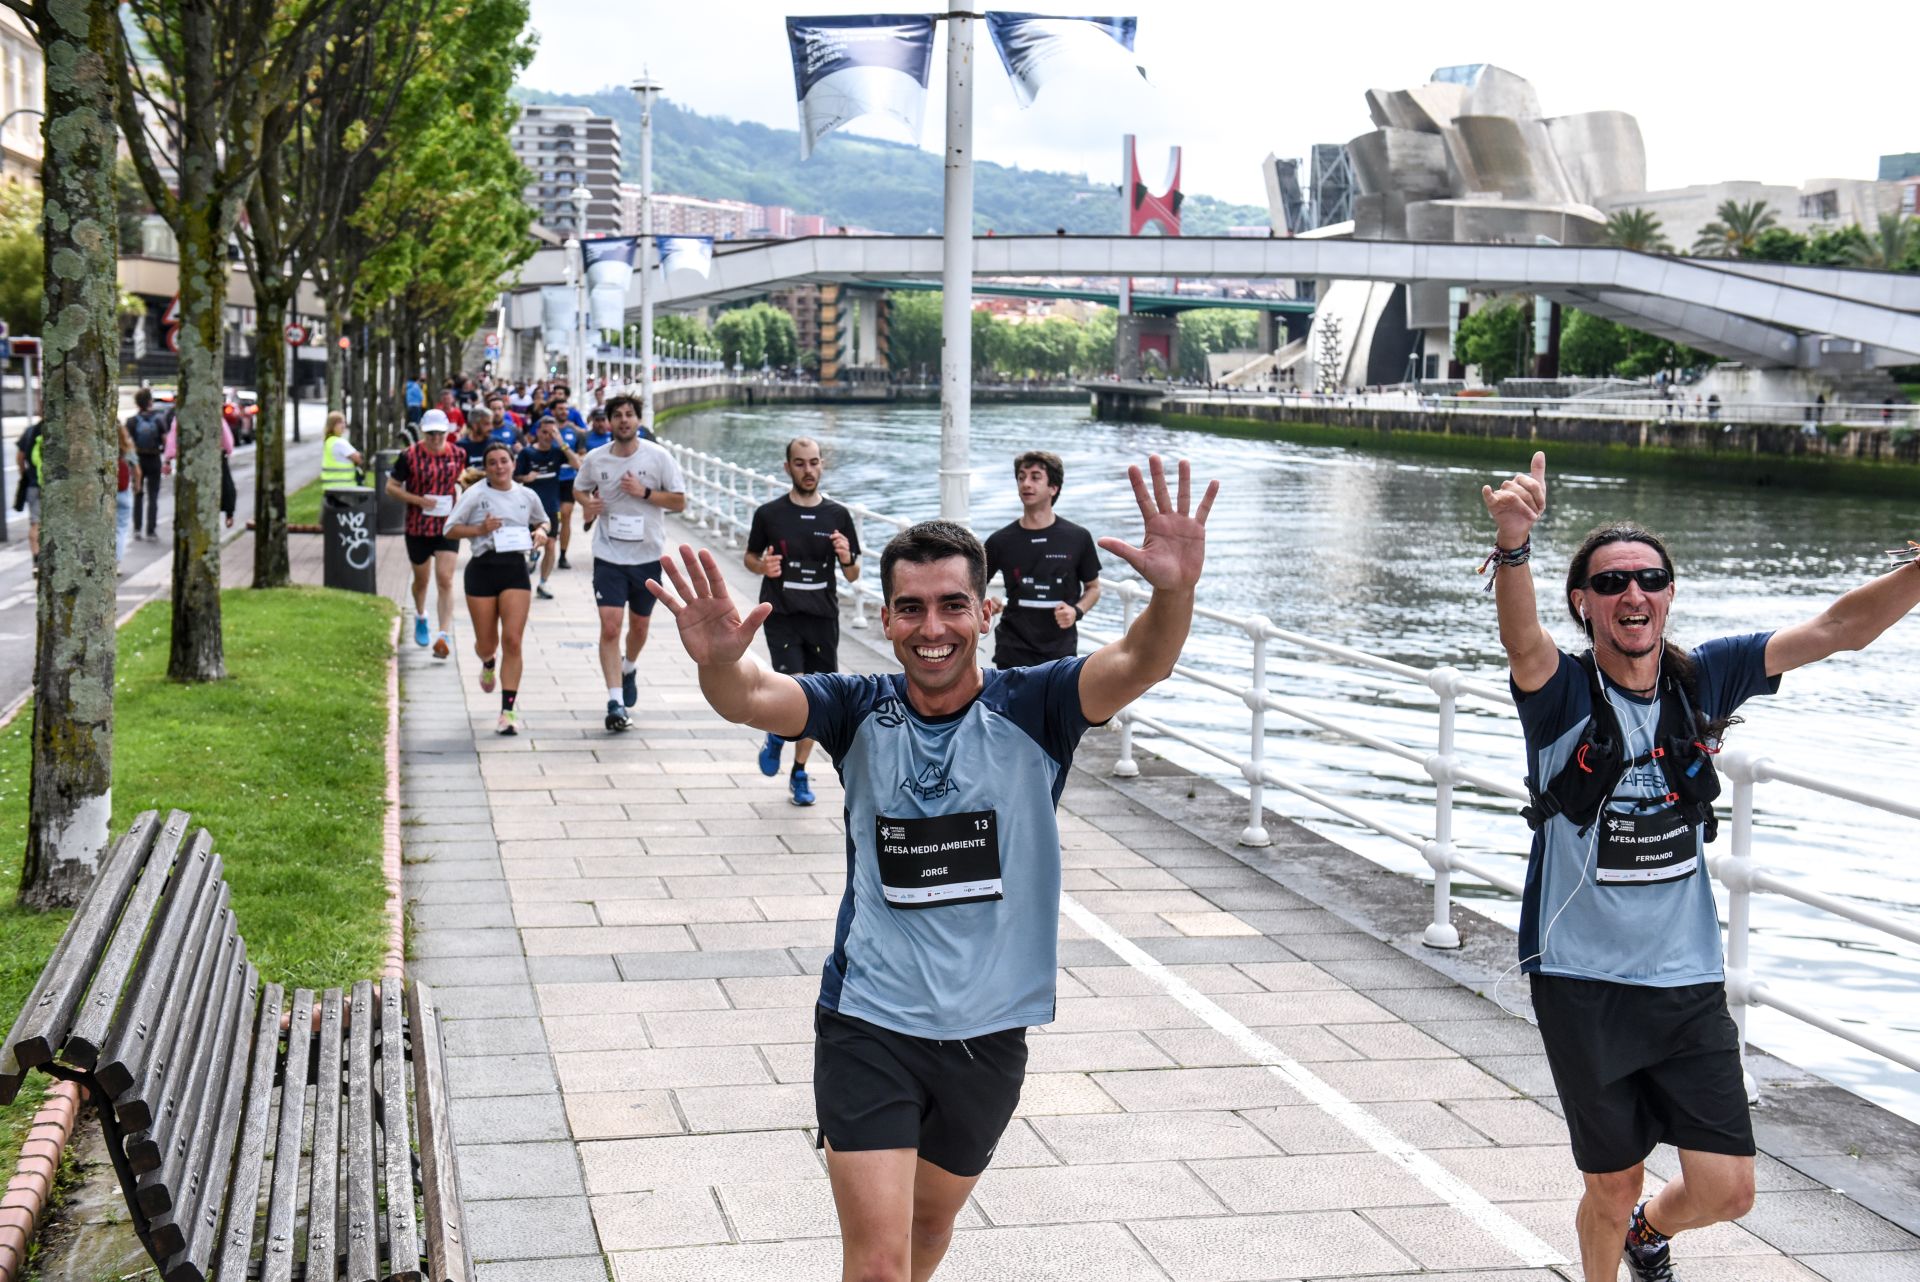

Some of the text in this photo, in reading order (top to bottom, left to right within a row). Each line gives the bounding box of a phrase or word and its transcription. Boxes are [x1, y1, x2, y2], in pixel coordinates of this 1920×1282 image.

[899, 777, 960, 801] AFESA
[1621, 773, 1666, 789] AFES
[974, 819, 989, 831] 13
[1609, 824, 1689, 844] AFESA MEDIO AMBIENTE
[884, 838, 986, 855] AFESA MEDIO AMBIENTE
[1635, 851, 1673, 862] FERNANDO
[920, 866, 948, 878] JORGE
